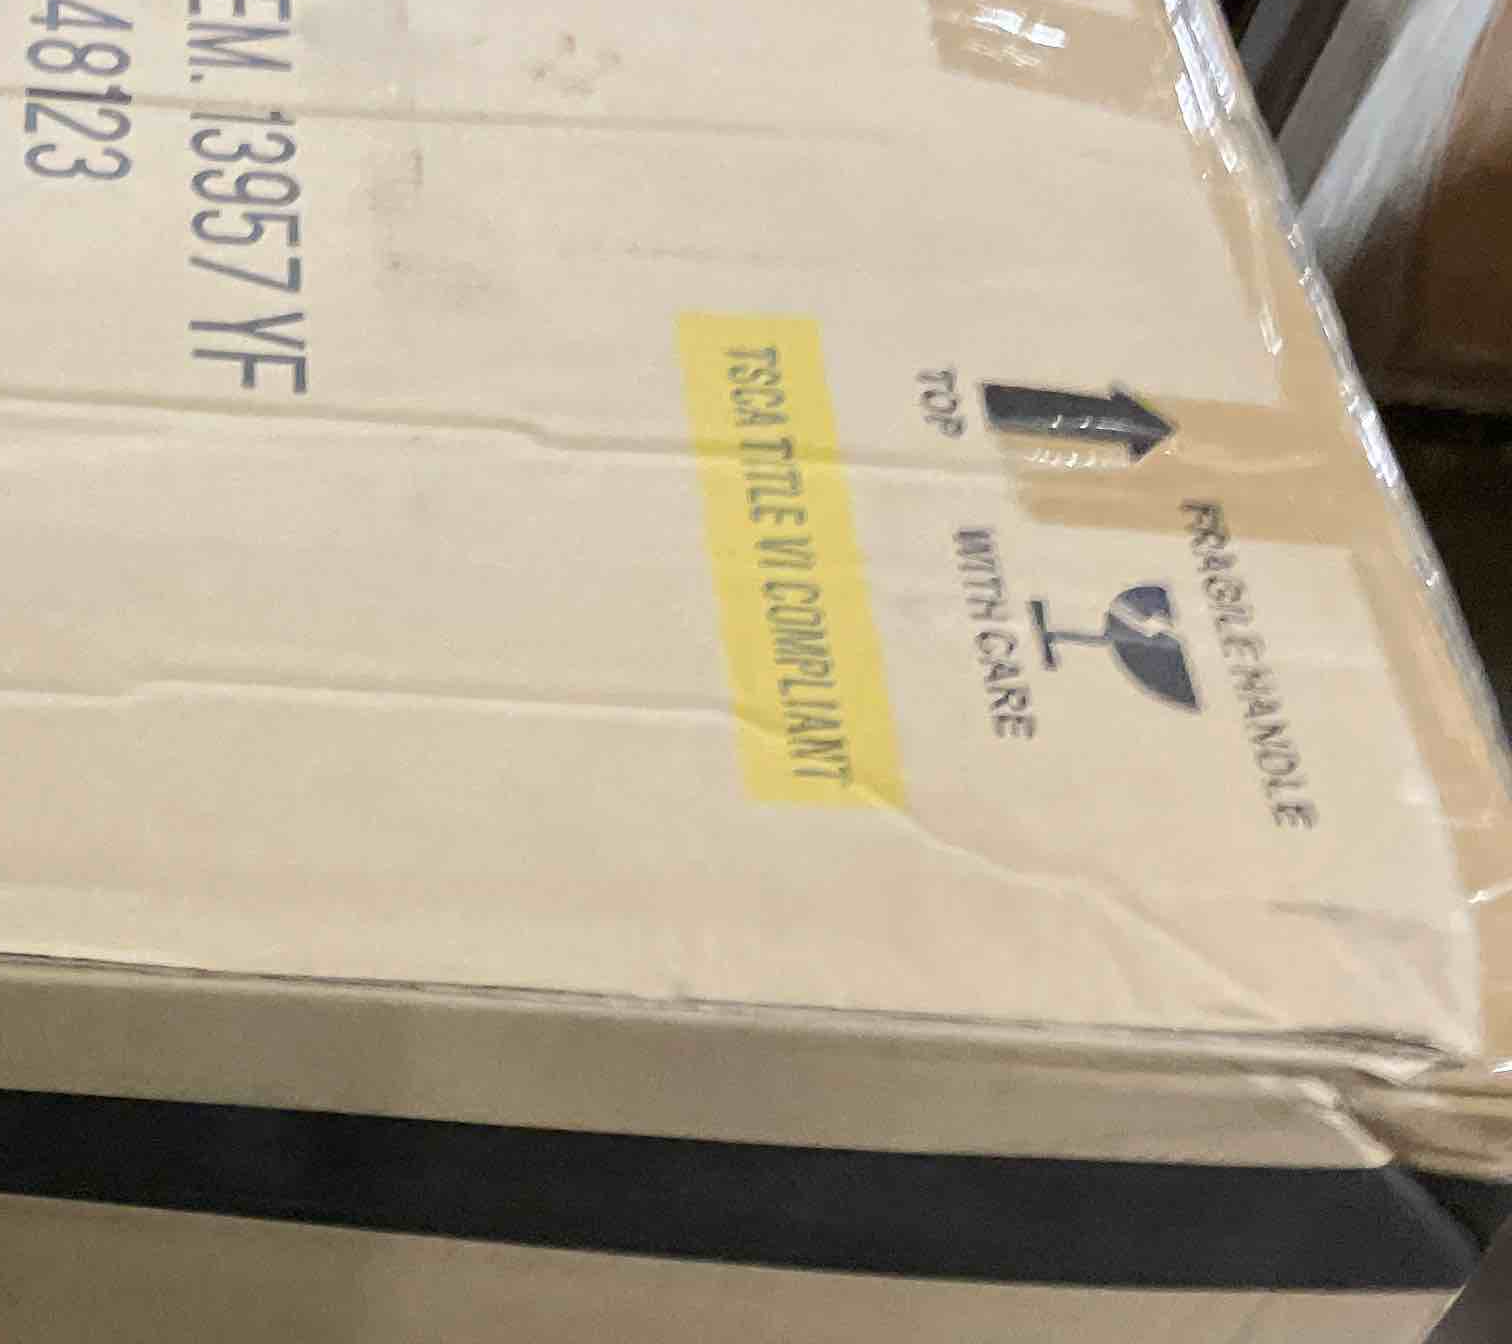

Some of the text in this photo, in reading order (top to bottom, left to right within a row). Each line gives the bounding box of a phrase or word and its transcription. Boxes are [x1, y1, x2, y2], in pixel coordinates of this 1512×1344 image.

[915, 366, 964, 438] TOP
[724, 346, 852, 787] TSCA TITLE VI COMPLIANT
[952, 527, 1037, 740] WITH CARE
[1179, 499, 1319, 830] FRAGILE HANDLE
